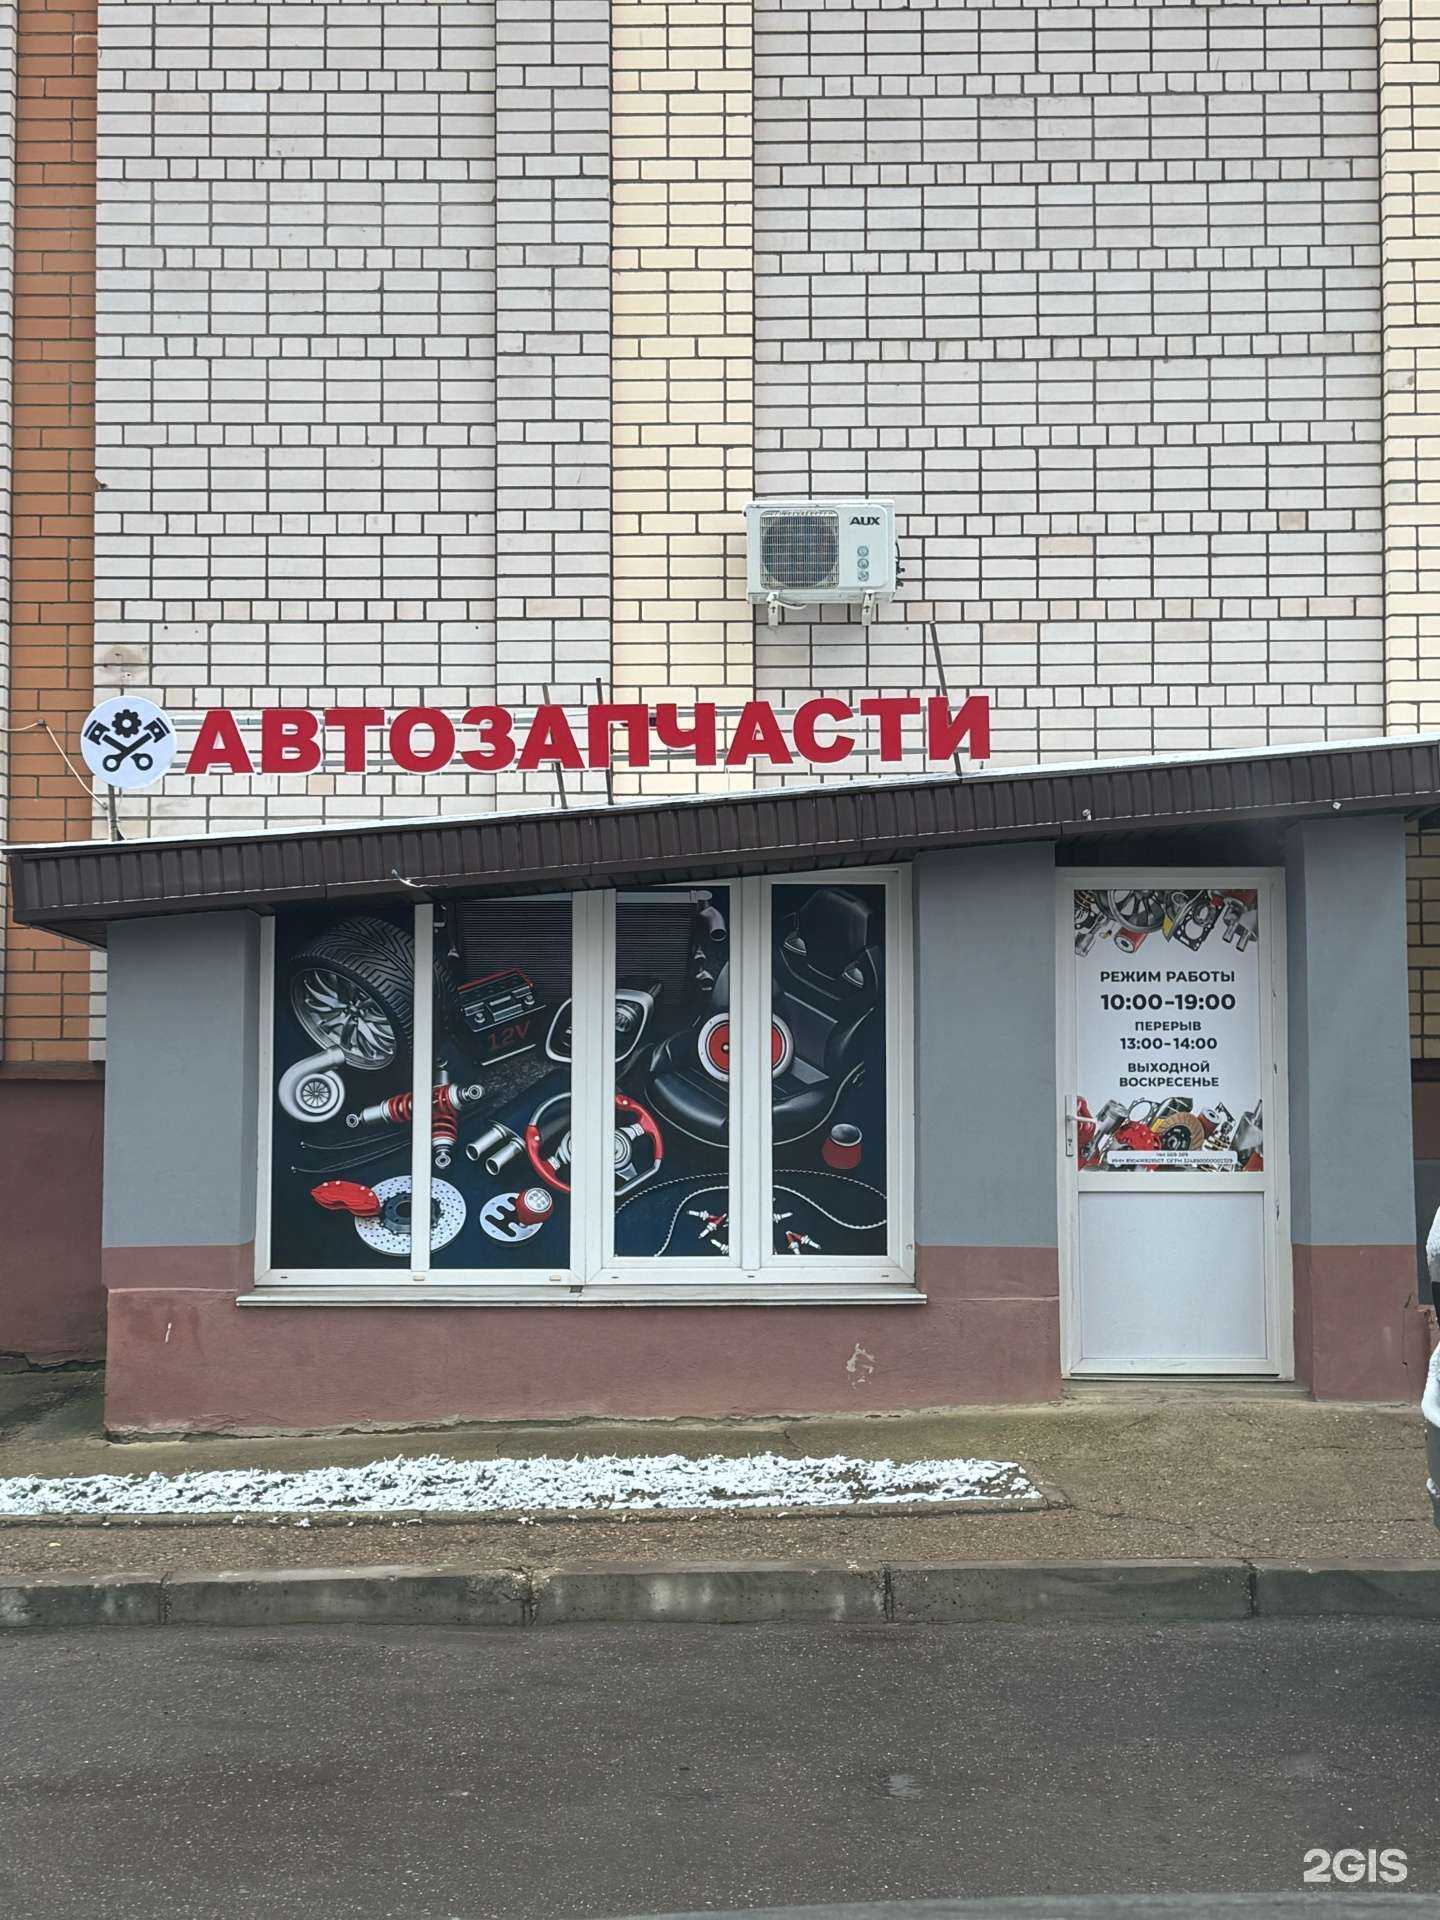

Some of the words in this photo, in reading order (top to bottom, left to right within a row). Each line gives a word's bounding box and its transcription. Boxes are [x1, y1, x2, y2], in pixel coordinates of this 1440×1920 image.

[850, 516, 880, 525] AUX
[185, 695, 991, 774] АВТОЗАПЧАСТИ
[1101, 971, 1161, 982] РЕЖИМ
[1166, 971, 1235, 982] РАБОТЫ
[1135, 1021, 1202, 1031] ПЕРЕРЫВ
[488, 1020, 530, 1051] 12V
[1128, 1060, 1210, 1074] ВЫХОДНОЙ
[1120, 1077, 1219, 1087] ВОСКРЕСЕНЬЕ
